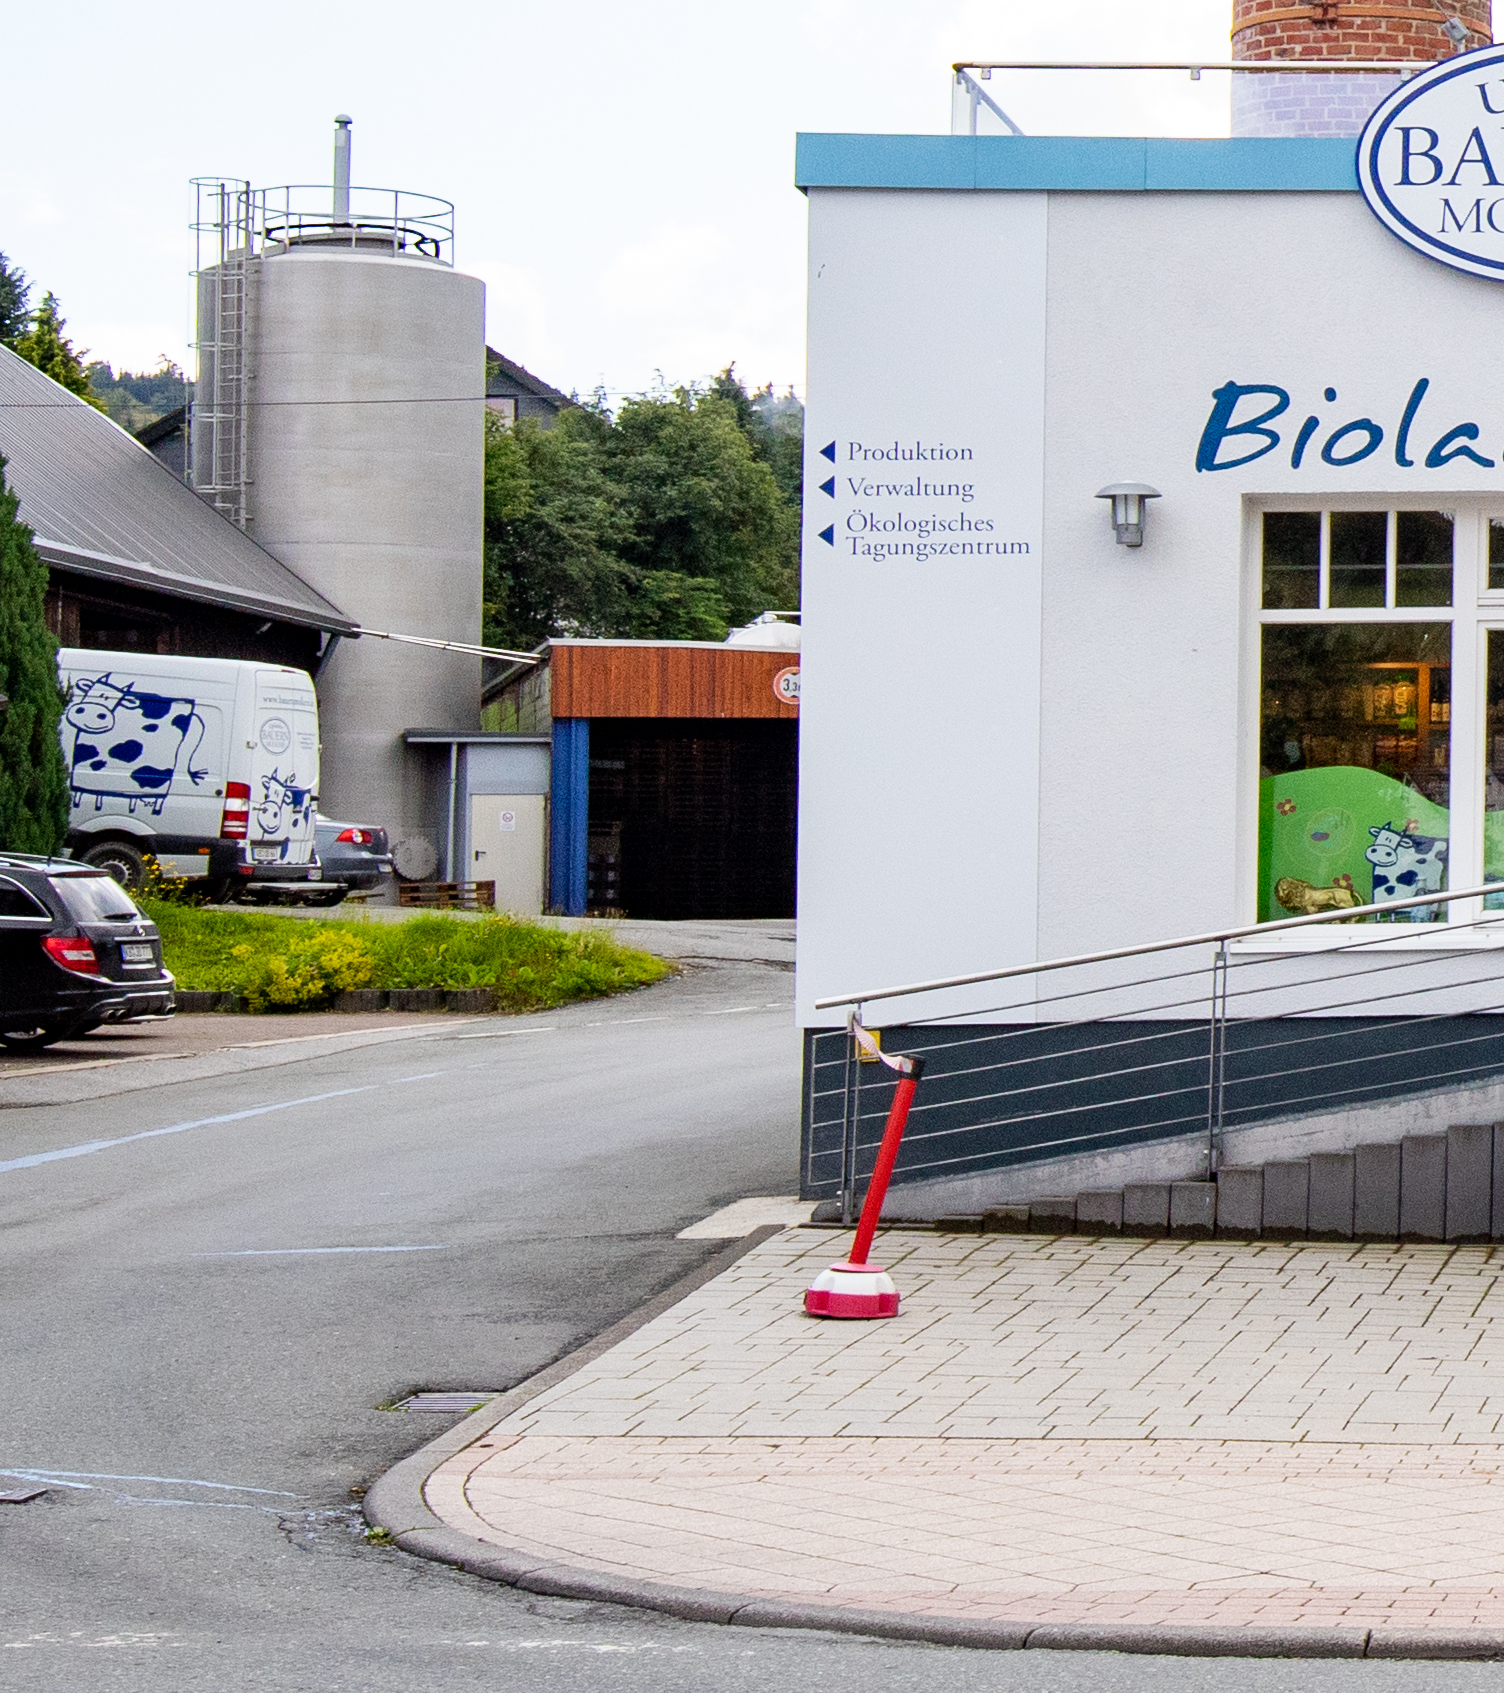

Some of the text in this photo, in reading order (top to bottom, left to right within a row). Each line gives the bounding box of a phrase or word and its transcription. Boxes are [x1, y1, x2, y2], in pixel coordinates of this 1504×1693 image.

[848, 441, 973, 461] Produktion
[846, 476, 974, 503] Verwaltung
[846, 509, 995, 538] Ökologisches
[845, 536, 1030, 562] Tagungszentrum
